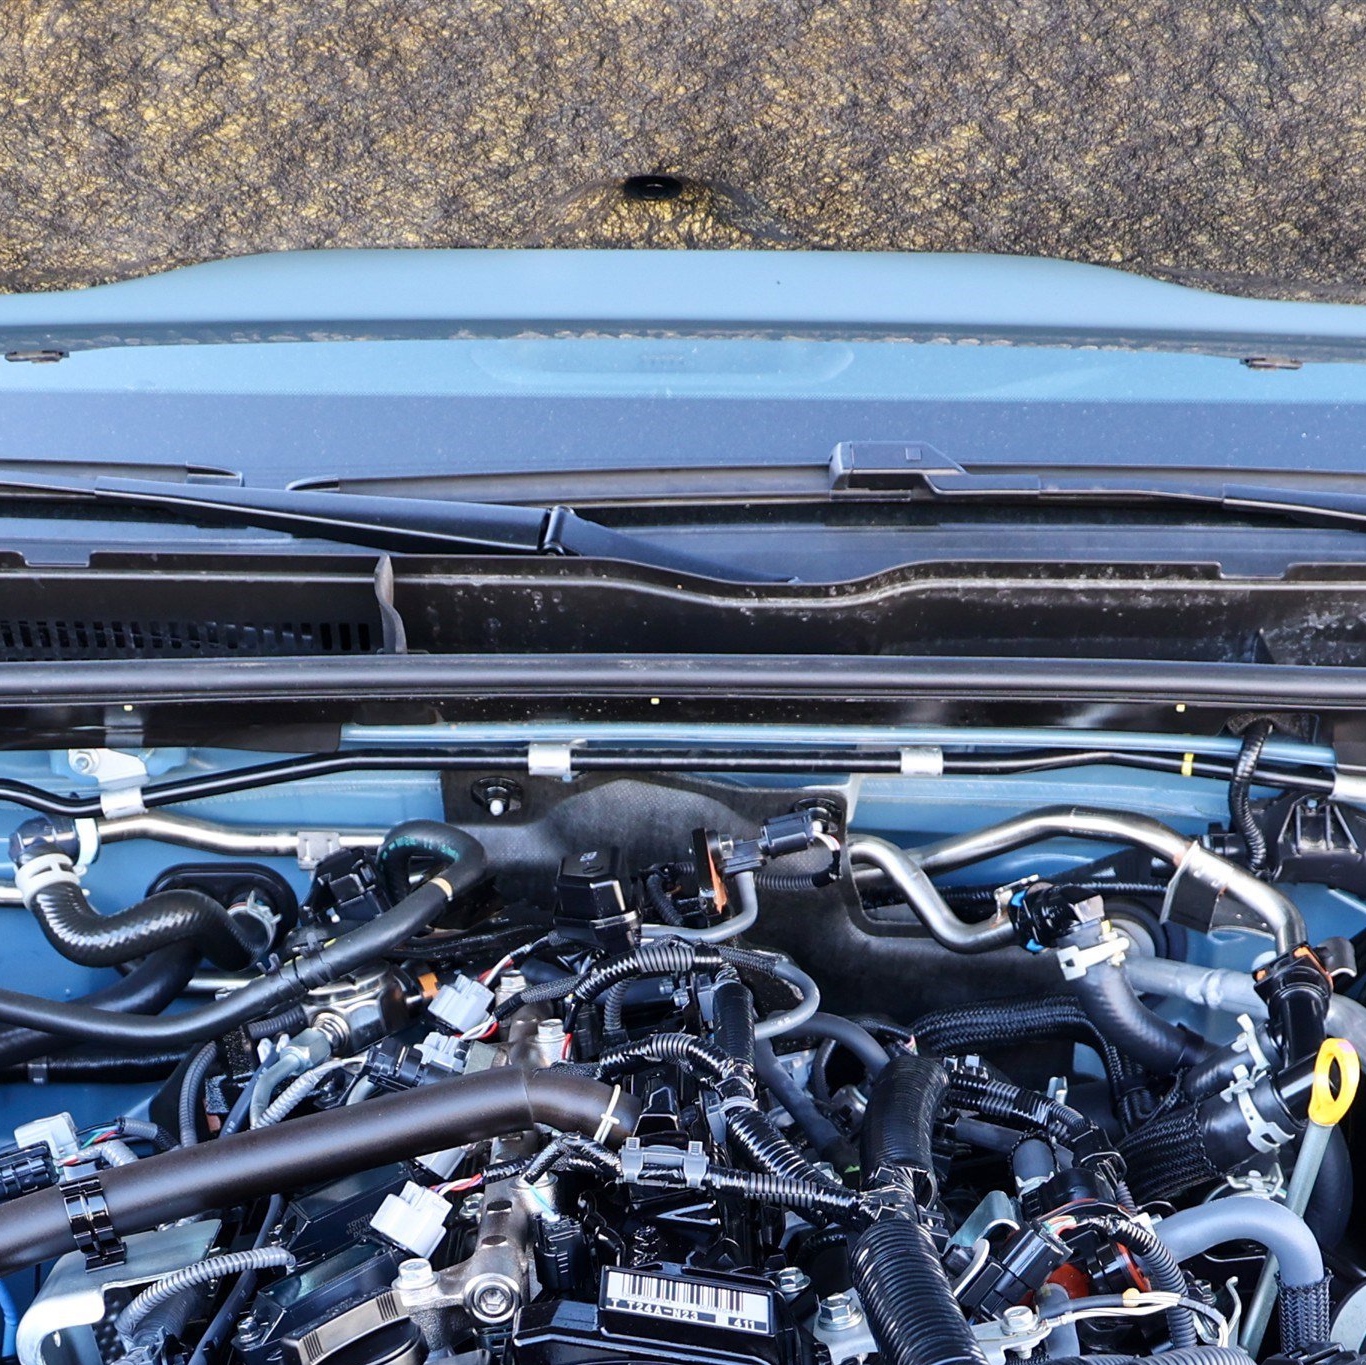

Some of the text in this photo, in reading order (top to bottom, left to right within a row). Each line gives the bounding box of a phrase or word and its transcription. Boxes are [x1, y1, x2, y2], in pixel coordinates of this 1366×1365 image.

[347, 1212, 374, 1228] TOYOTA
[627, 1300, 698, 1320] T24A-N23
[734, 1318, 756, 1330] 411
